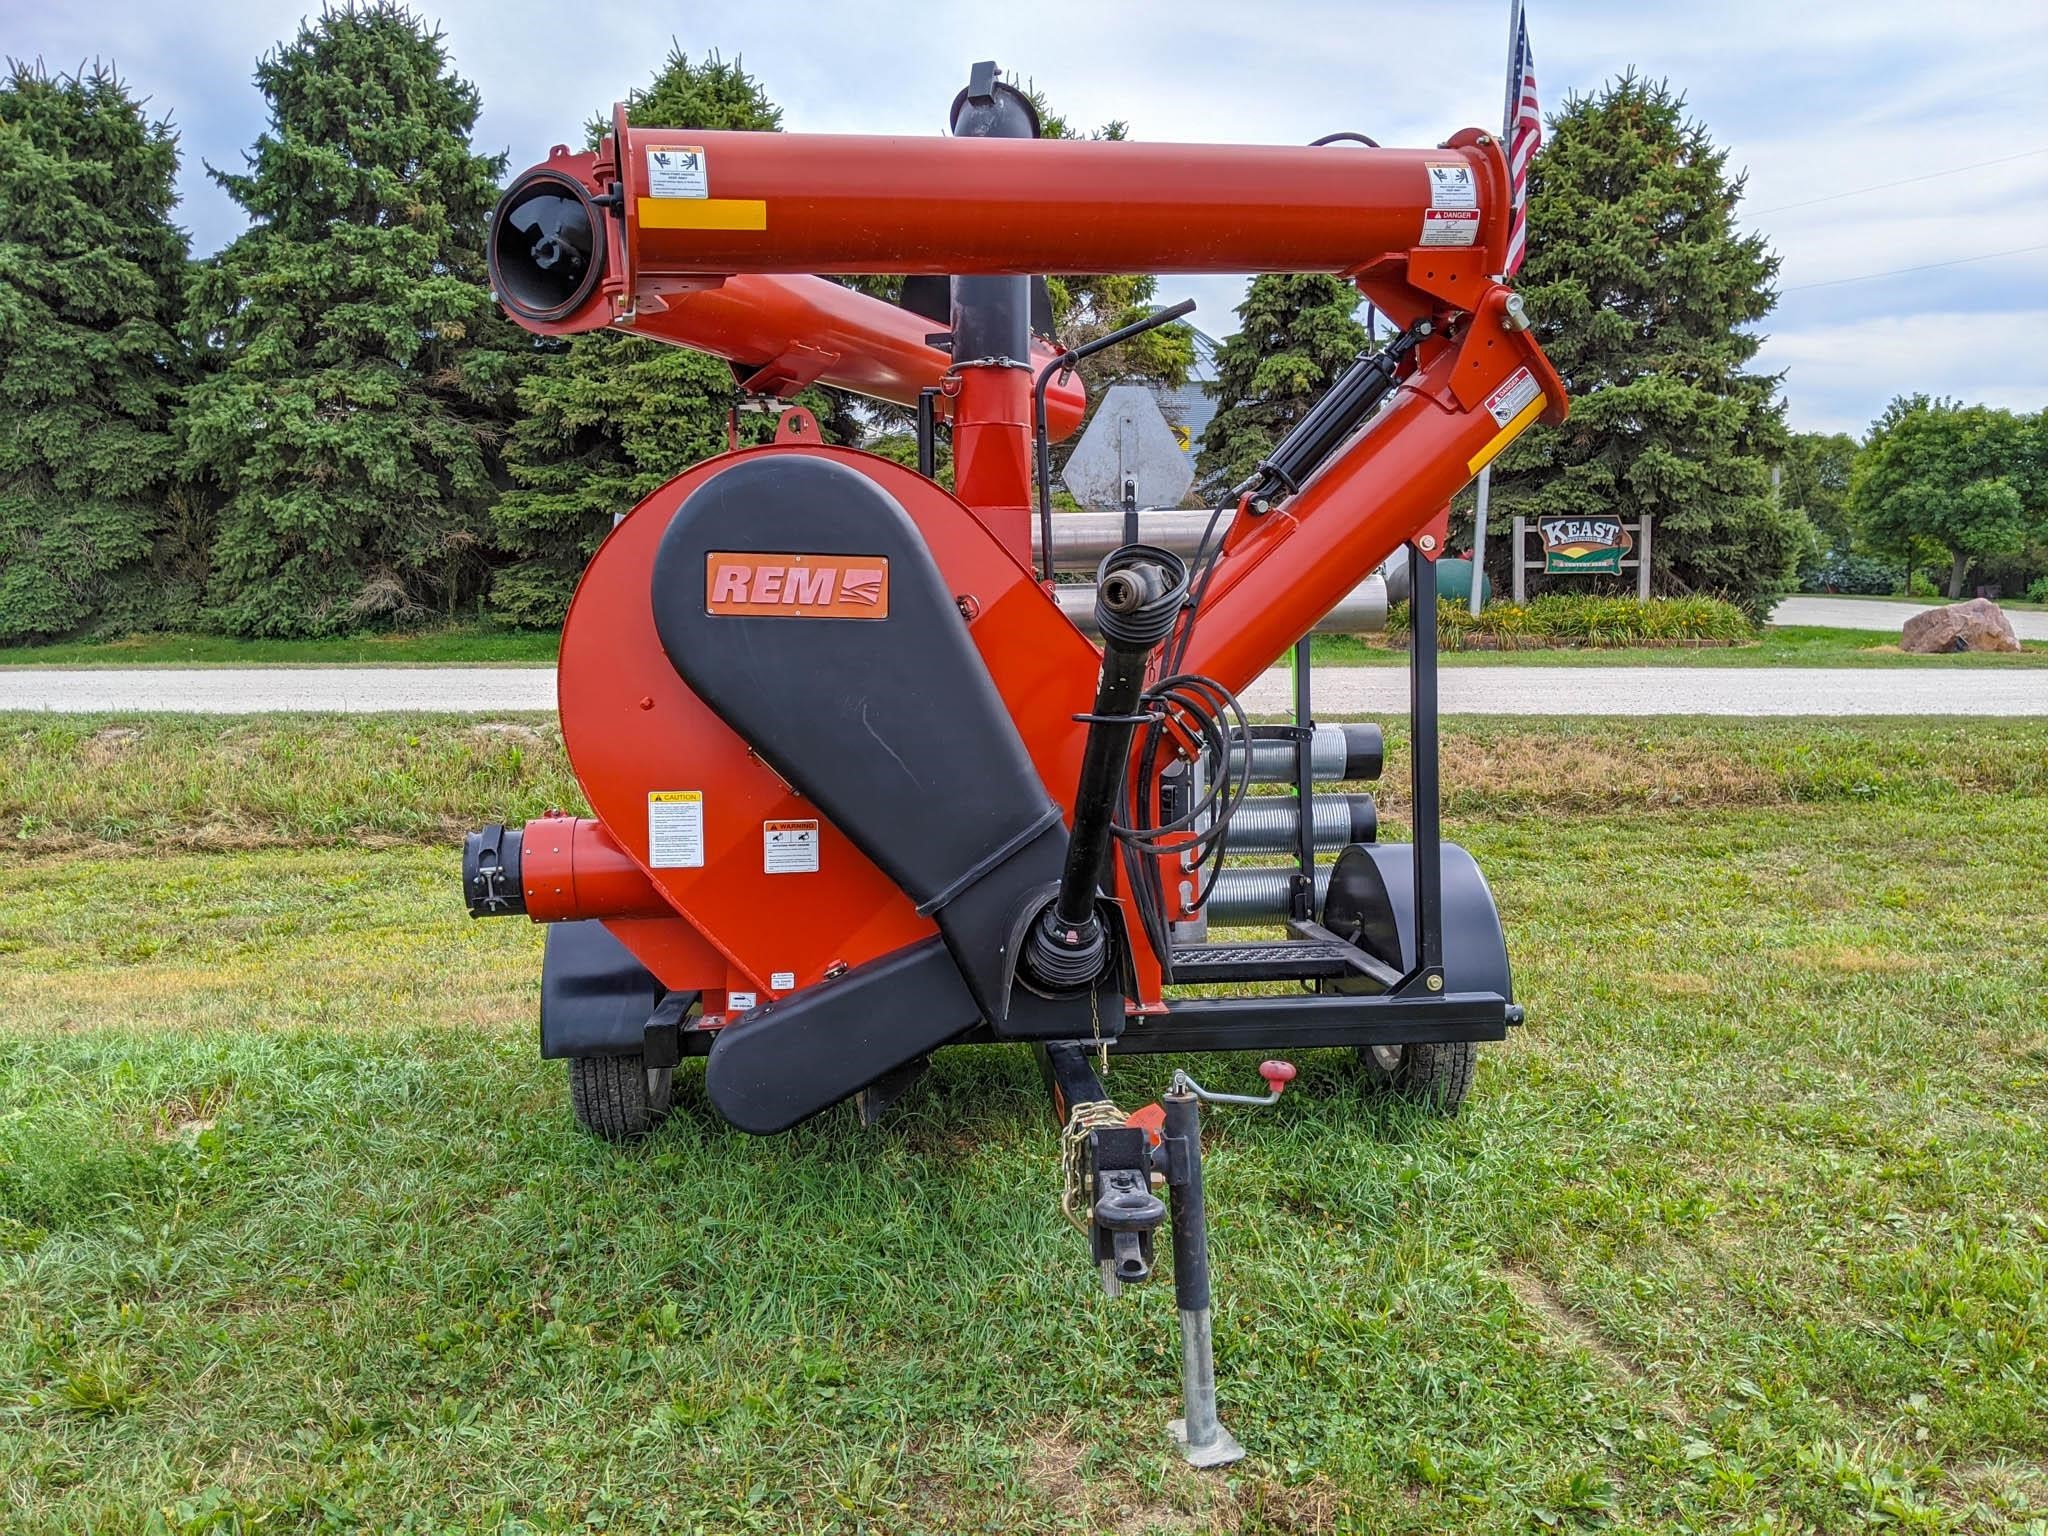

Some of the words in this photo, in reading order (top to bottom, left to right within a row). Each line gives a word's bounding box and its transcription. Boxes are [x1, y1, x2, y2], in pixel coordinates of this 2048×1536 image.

[1499, 377, 1520, 397] DANGER
[1542, 520, 1619, 547] KEAST
[711, 565, 837, 605] REM
